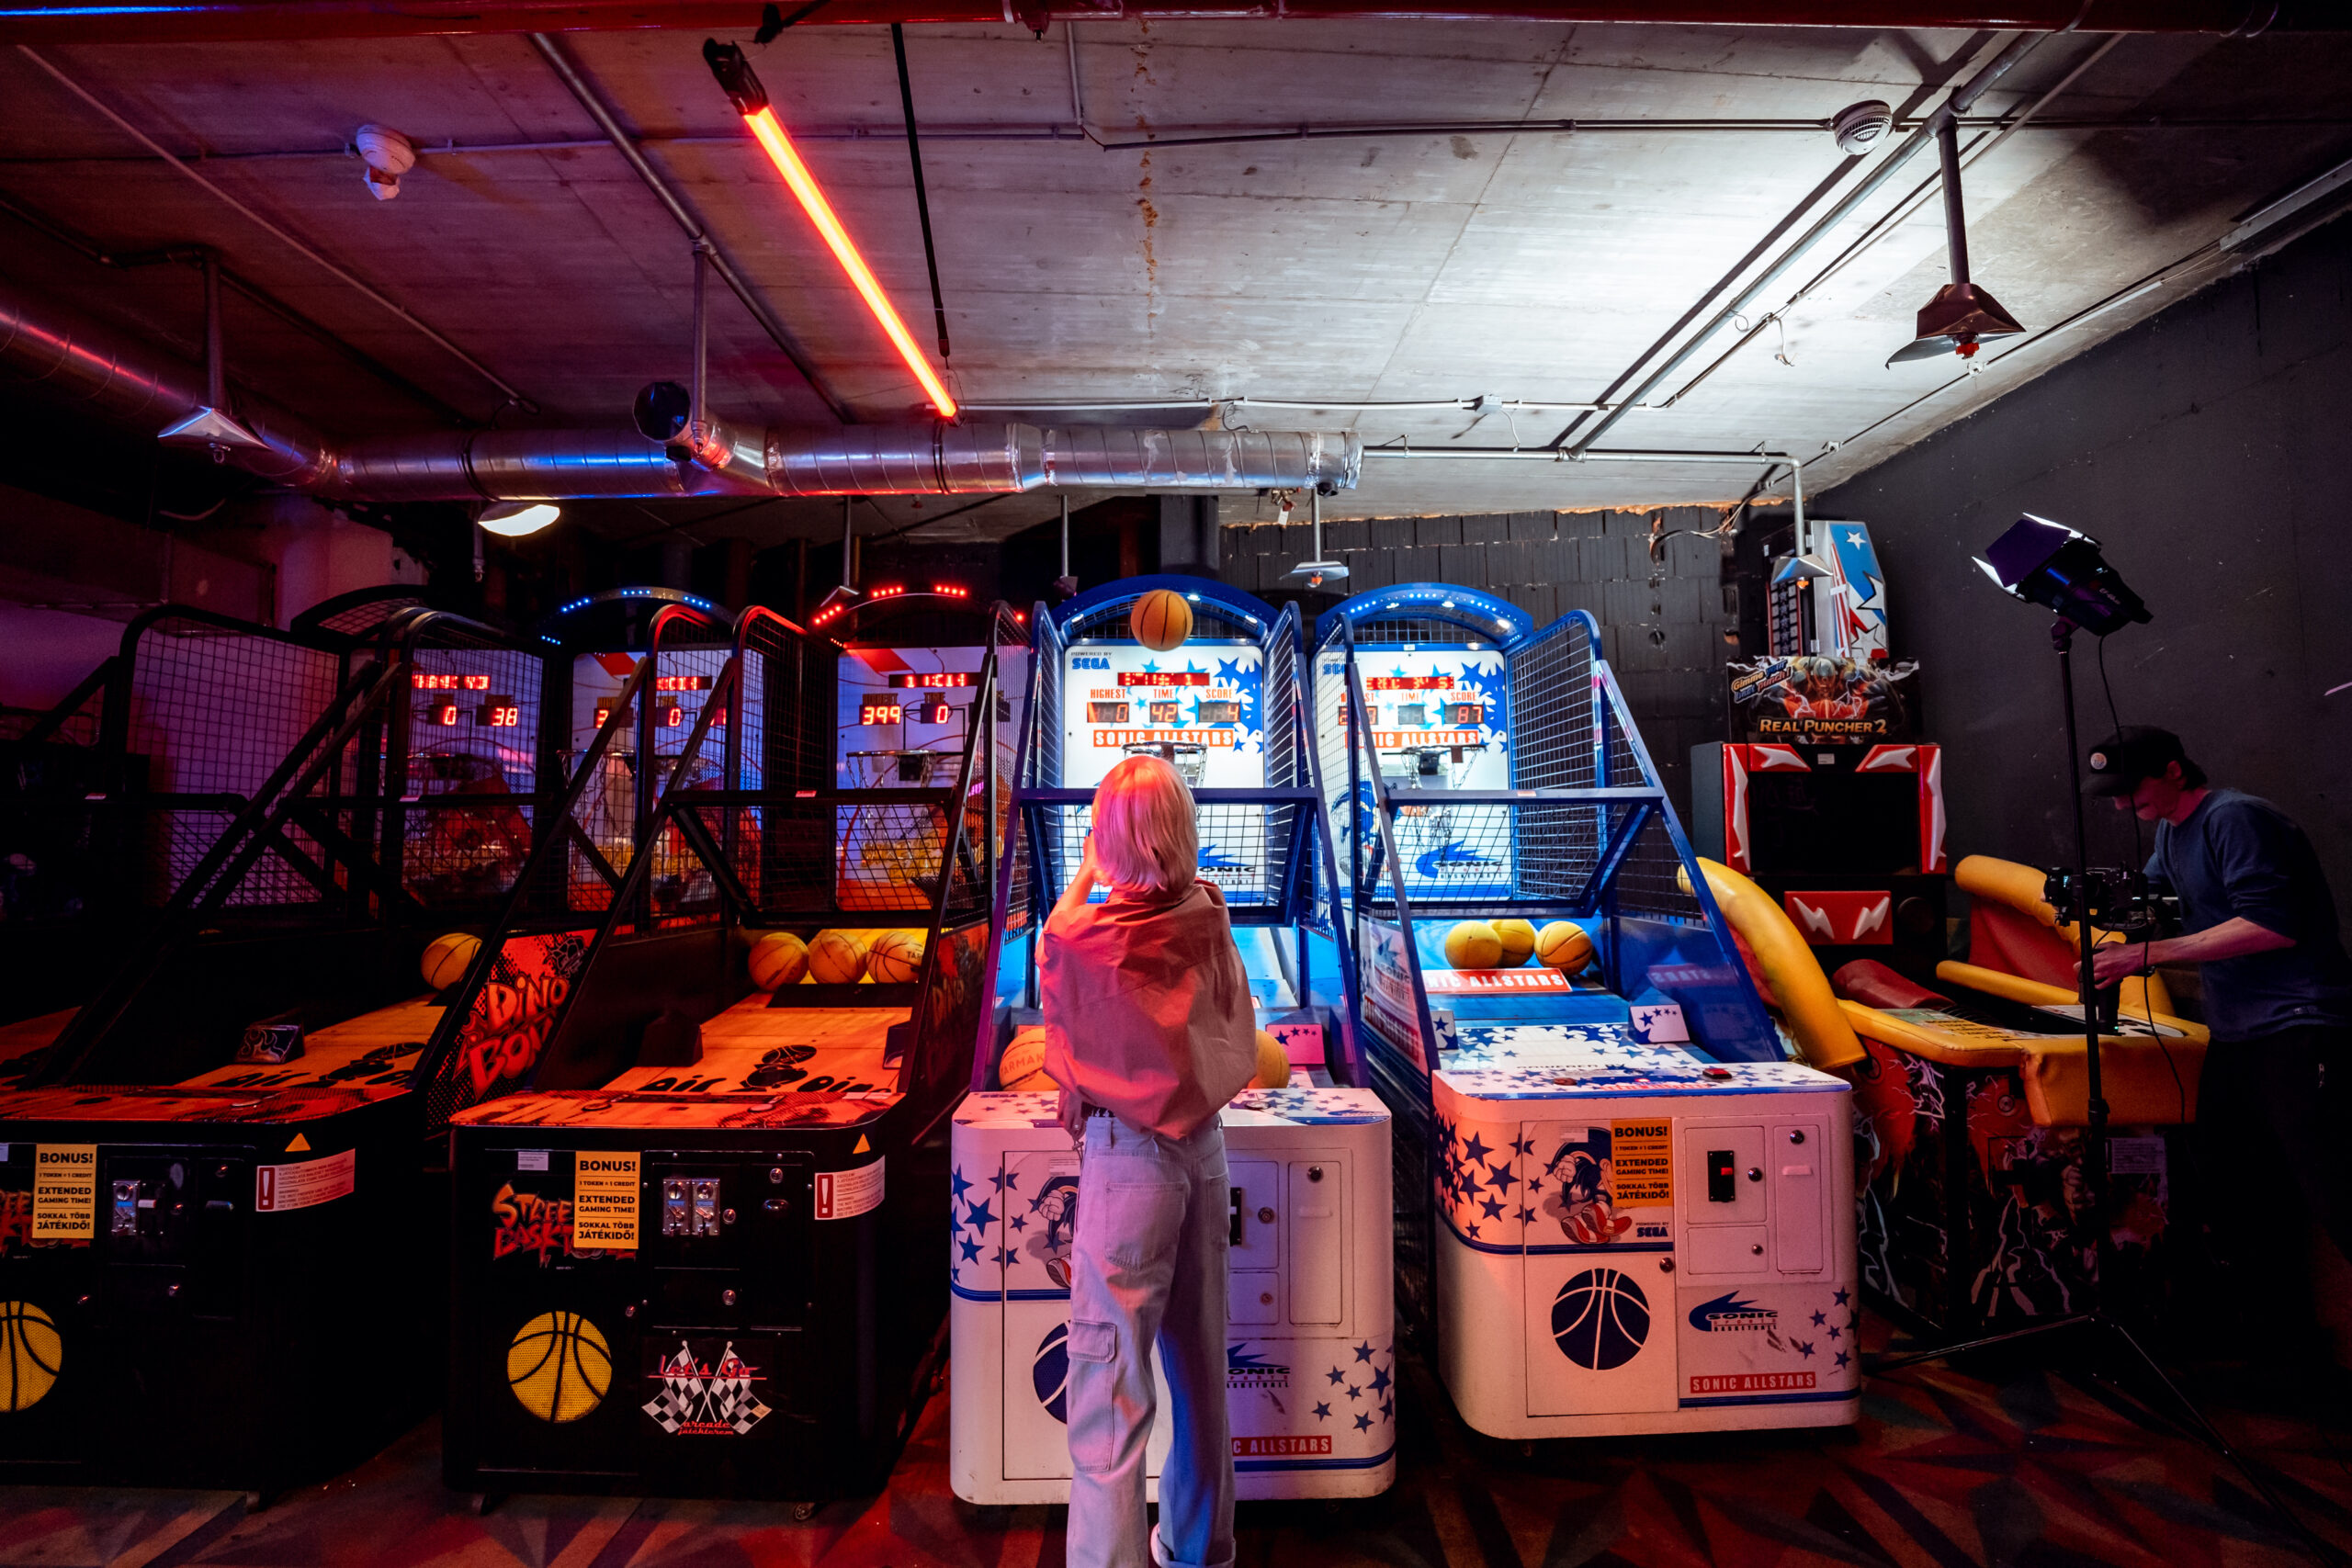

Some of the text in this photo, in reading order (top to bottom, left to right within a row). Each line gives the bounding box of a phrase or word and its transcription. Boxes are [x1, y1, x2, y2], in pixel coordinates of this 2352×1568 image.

[1072, 658, 1110, 670] SEGA
[1733, 671, 1764, 691] Gimme
[1091, 689, 1236, 698] HIGHEST TIME SCORE
[1450, 692, 1476, 701] SCORE
[444, 705, 518, 726] 0 38
[668, 707, 681, 726] 0
[862, 705, 948, 725] 399 0
[1116, 704, 1239, 722] 0 42 4
[1456, 706, 1482, 724] 87
[1759, 717, 1889, 734] REAL PUNCHER 2
[1095, 731, 1232, 746] SONIC ALLSTARS
[1403, 732, 1477, 746] ALLSTARS
[1470, 975, 1565, 987] ALLSTARS
[1614, 1126, 1668, 1137] BONUS!
[40, 1153, 93, 1163] BONUS!
[1615, 1158, 1668, 1167] EXTENDED
[580, 1161, 636, 1172] BONUS!
[39, 1187, 92, 1195] EXTENDED
[1617, 1190, 1669, 1199] JÁTÉKIDŐ!
[492, 1179, 575, 1229] STREE
[579, 1195, 635, 1204] EXTENDED
[37, 1220, 90, 1230] JÁTÉKIDŐ!
[613, 1221, 634, 1229] TÖBB
[579, 1229, 634, 1240] JÁTÉKIDŐ!
[1636, 1227, 1668, 1237] SEGA
[1708, 1312, 1778, 1320] SONIC
[660, 1354, 711, 1375] Let's
[1692, 1374, 1814, 1391] SONIC ALLSTARS
[683, 1419, 731, 1428] arcade
[1250, 1438, 1329, 1453] ALLSTARS
